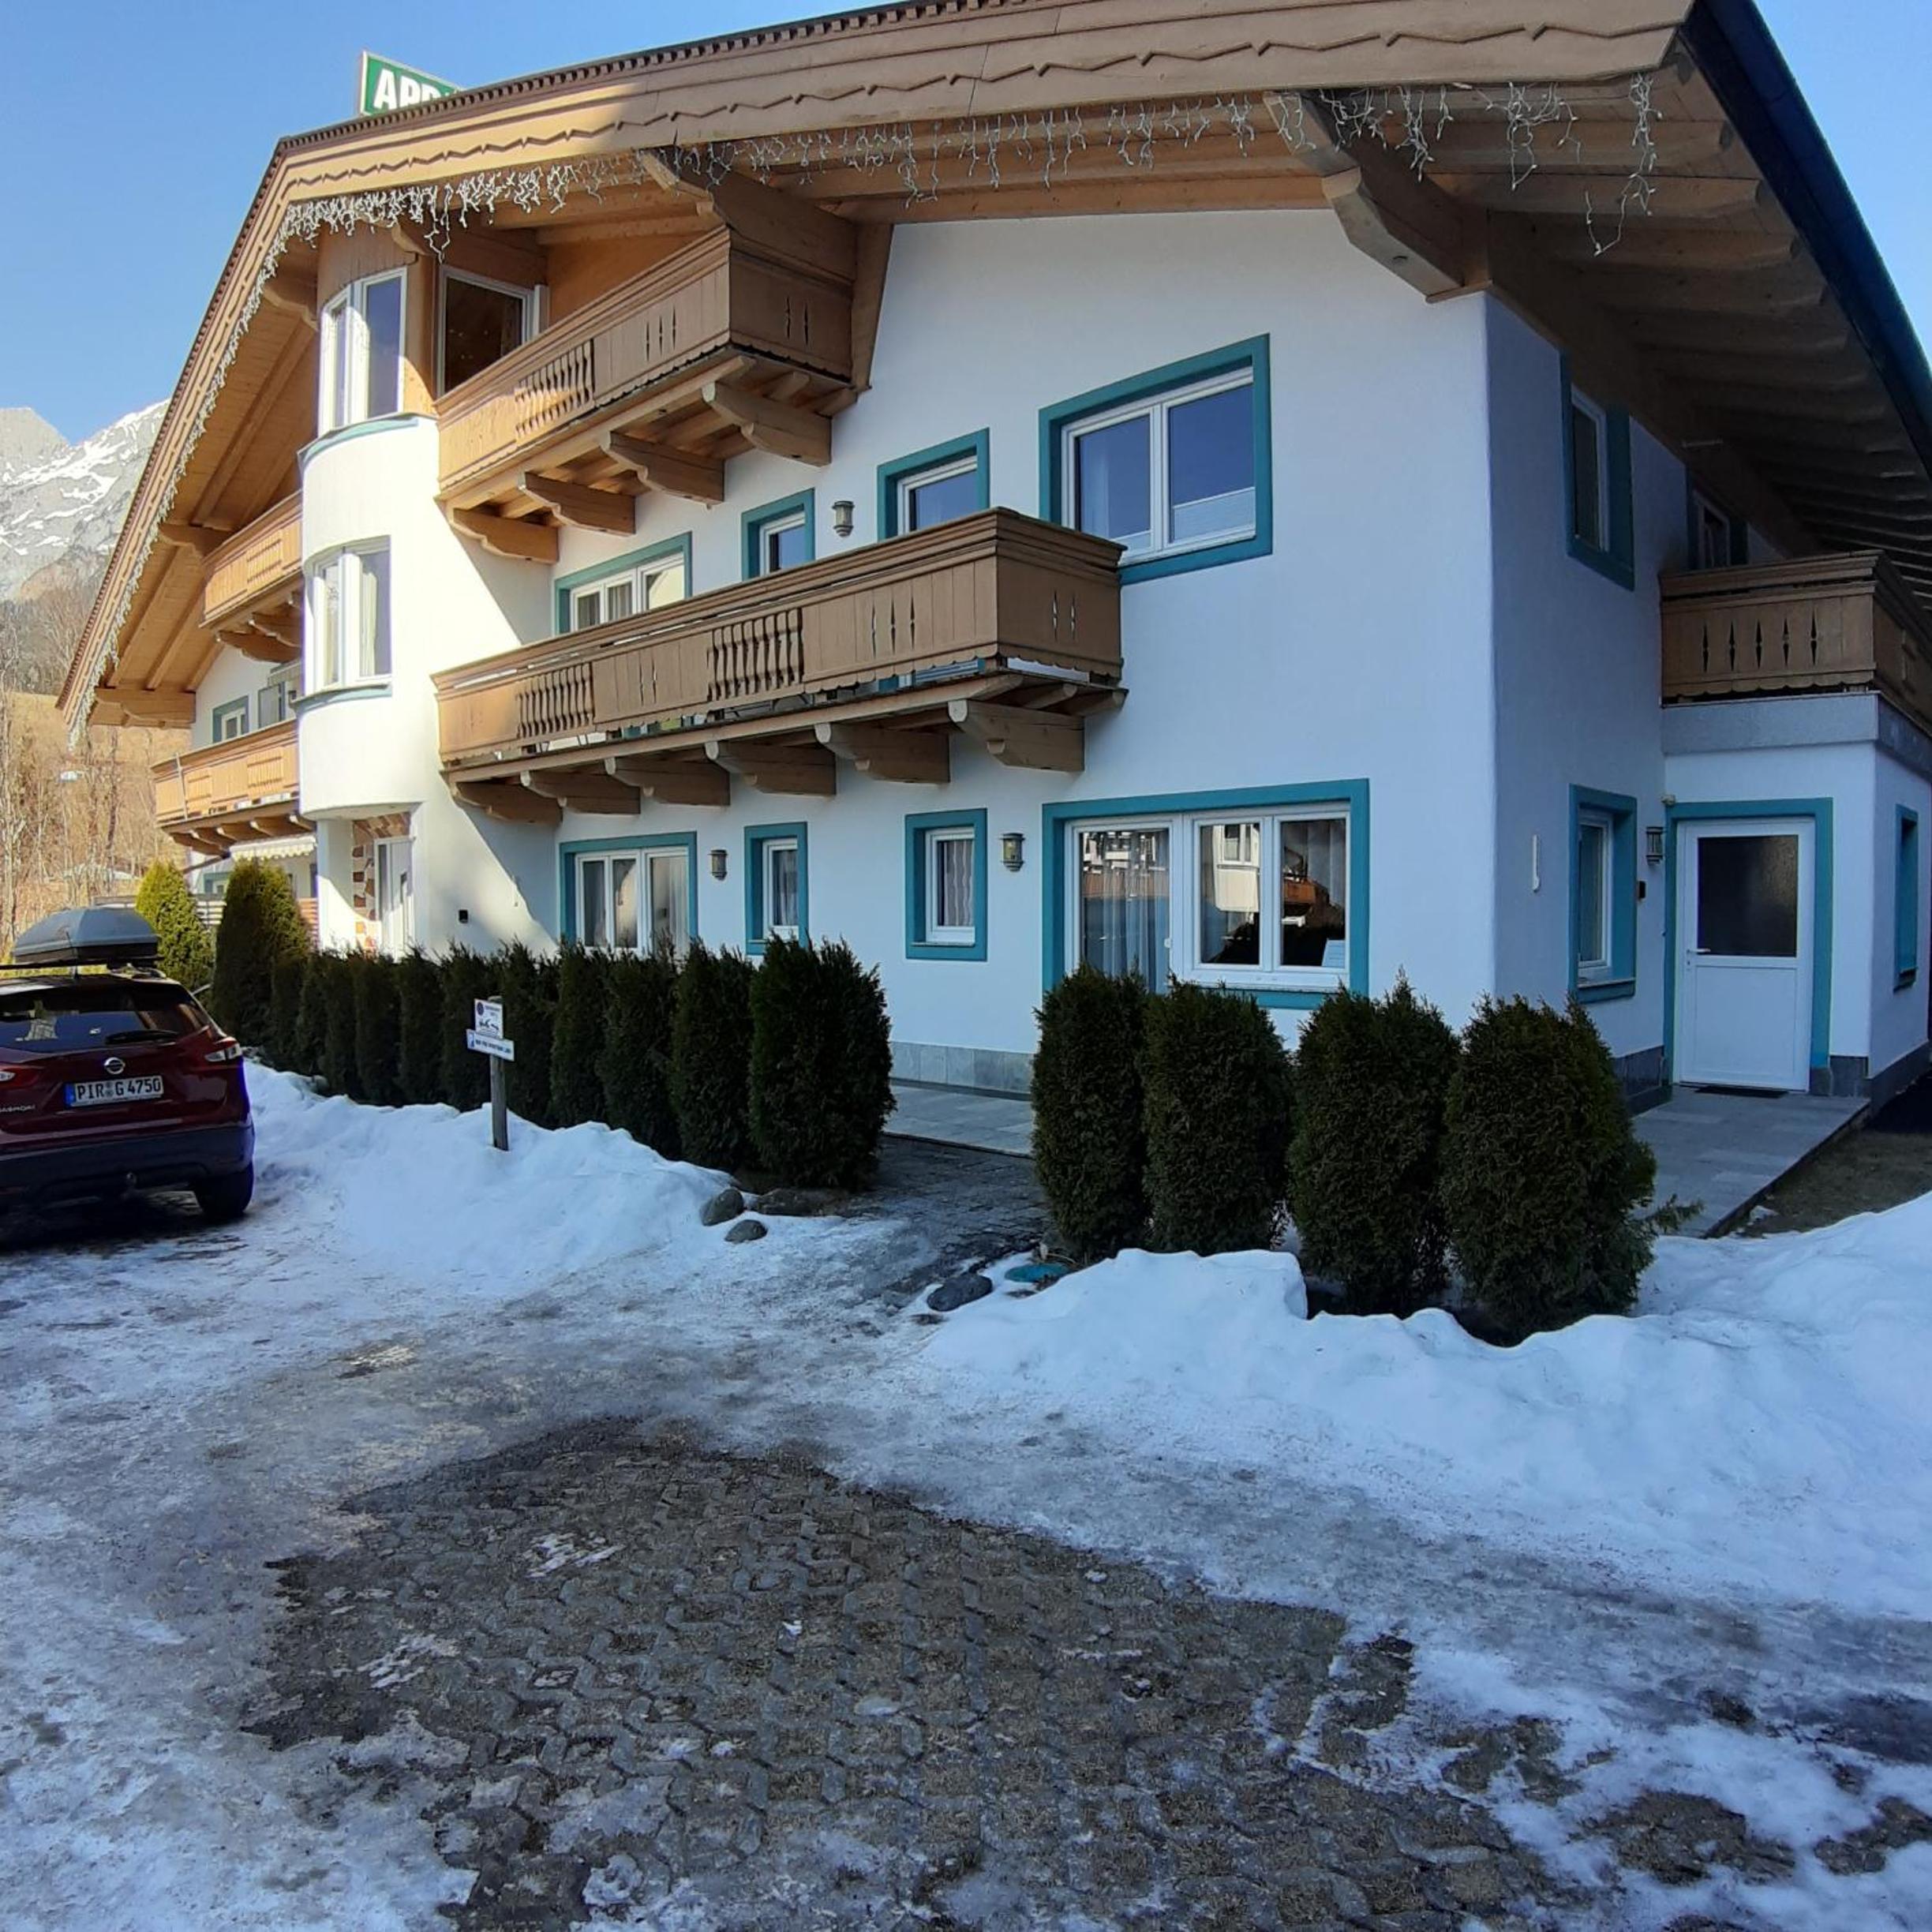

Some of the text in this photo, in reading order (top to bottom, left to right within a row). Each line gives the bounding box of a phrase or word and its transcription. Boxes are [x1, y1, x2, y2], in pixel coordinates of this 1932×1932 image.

[77, 1083, 104, 1099] PIR
[115, 1081, 124, 1096] G
[128, 1078, 161, 1094] 4750
